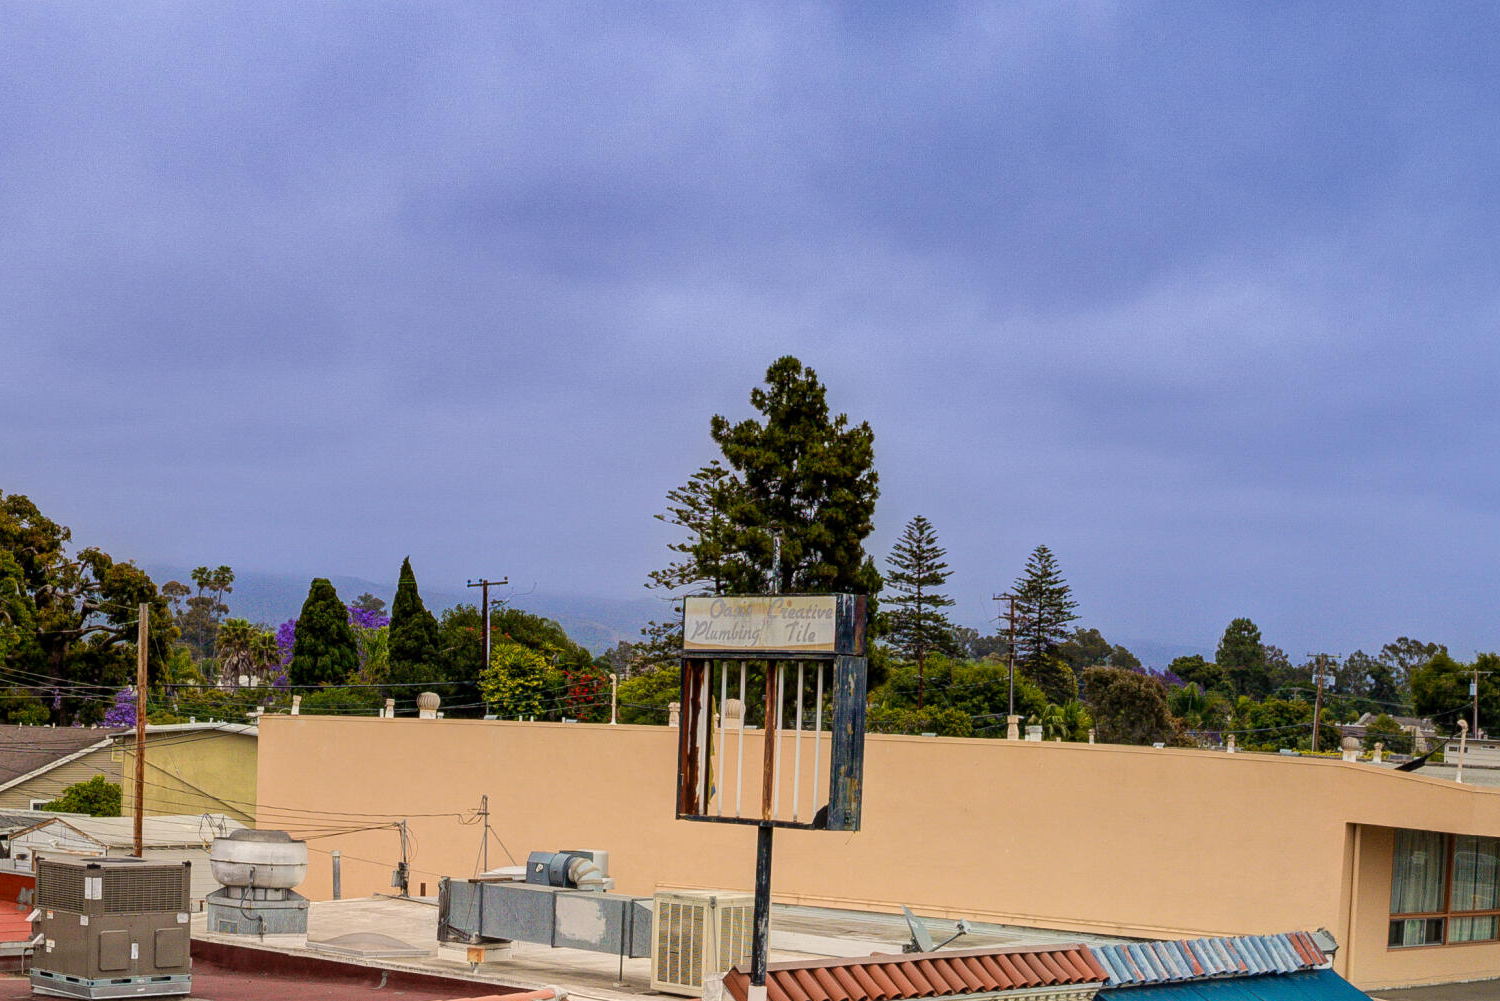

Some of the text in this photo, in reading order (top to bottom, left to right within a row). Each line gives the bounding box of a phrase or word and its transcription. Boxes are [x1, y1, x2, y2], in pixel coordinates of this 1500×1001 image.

[767, 598, 833, 620] Creative
[691, 620, 816, 647] Plumbing Tile
